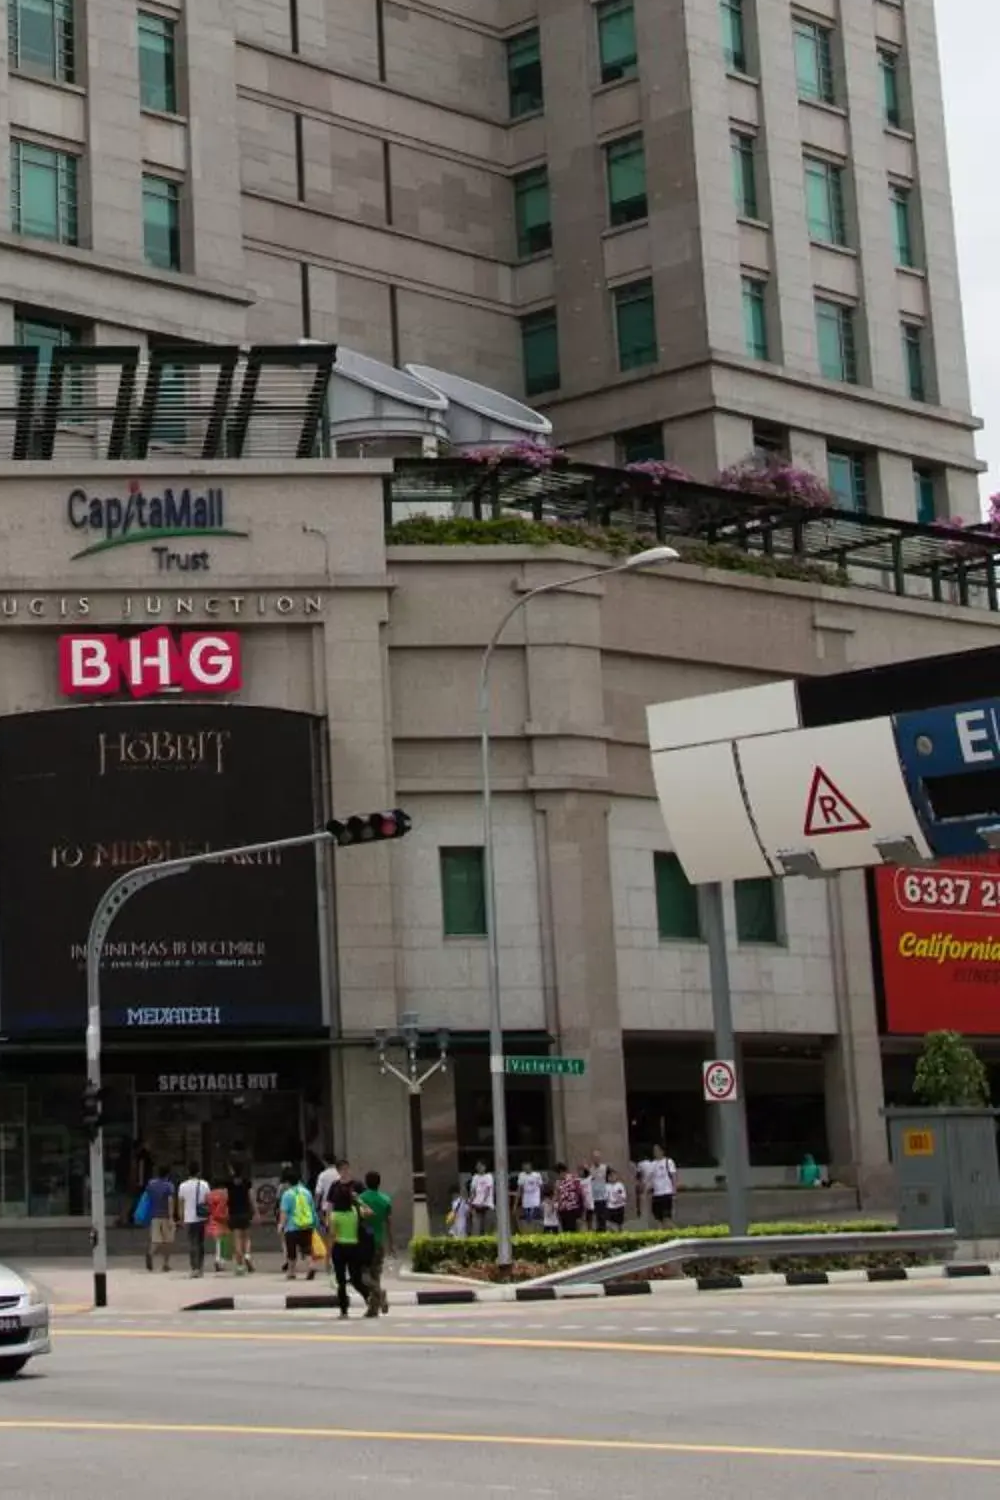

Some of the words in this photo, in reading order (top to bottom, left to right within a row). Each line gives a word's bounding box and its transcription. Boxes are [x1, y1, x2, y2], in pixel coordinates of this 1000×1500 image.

[67, 479, 224, 540] CapitaMall
[152, 547, 210, 571] Trust
[122, 595, 323, 616] JUNCTION
[70, 636, 234, 687] BHG
[956, 708, 1000, 763] E
[819, 795, 843, 825] R
[904, 875, 971, 905] 6337
[980, 880, 1000, 908] 2
[899, 932, 1000, 964] California
[157, 1073, 244, 1092] SPECTACLE
[246, 1072, 279, 1090] HUT
[511, 1059, 563, 1073] Victoria
[566, 1059, 581, 1074] St
